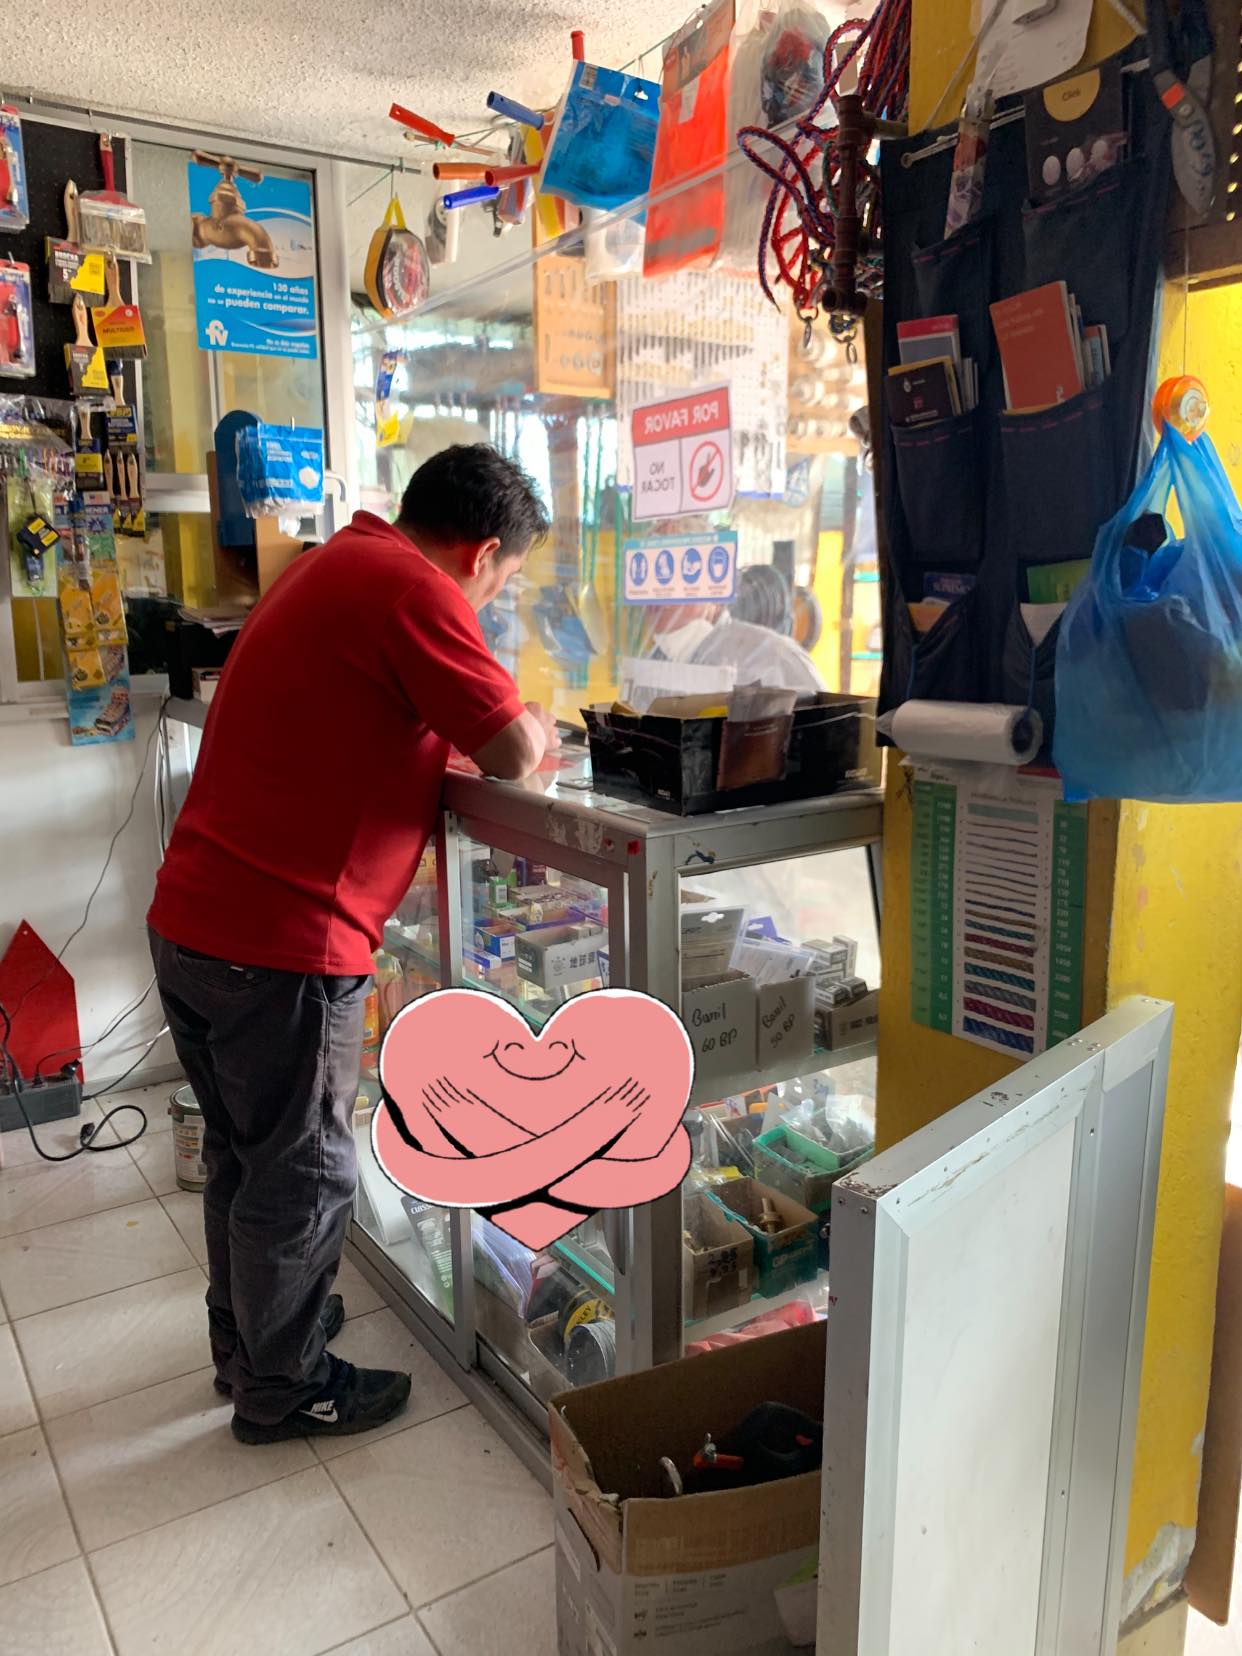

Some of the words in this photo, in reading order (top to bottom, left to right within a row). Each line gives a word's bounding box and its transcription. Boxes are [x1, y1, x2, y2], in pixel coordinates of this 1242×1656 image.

[214, 283, 226, 293] de
[227, 287, 272, 299] experiencia
[225, 297, 261, 309] pueden
[310, 1399, 335, 1413] NIKE
